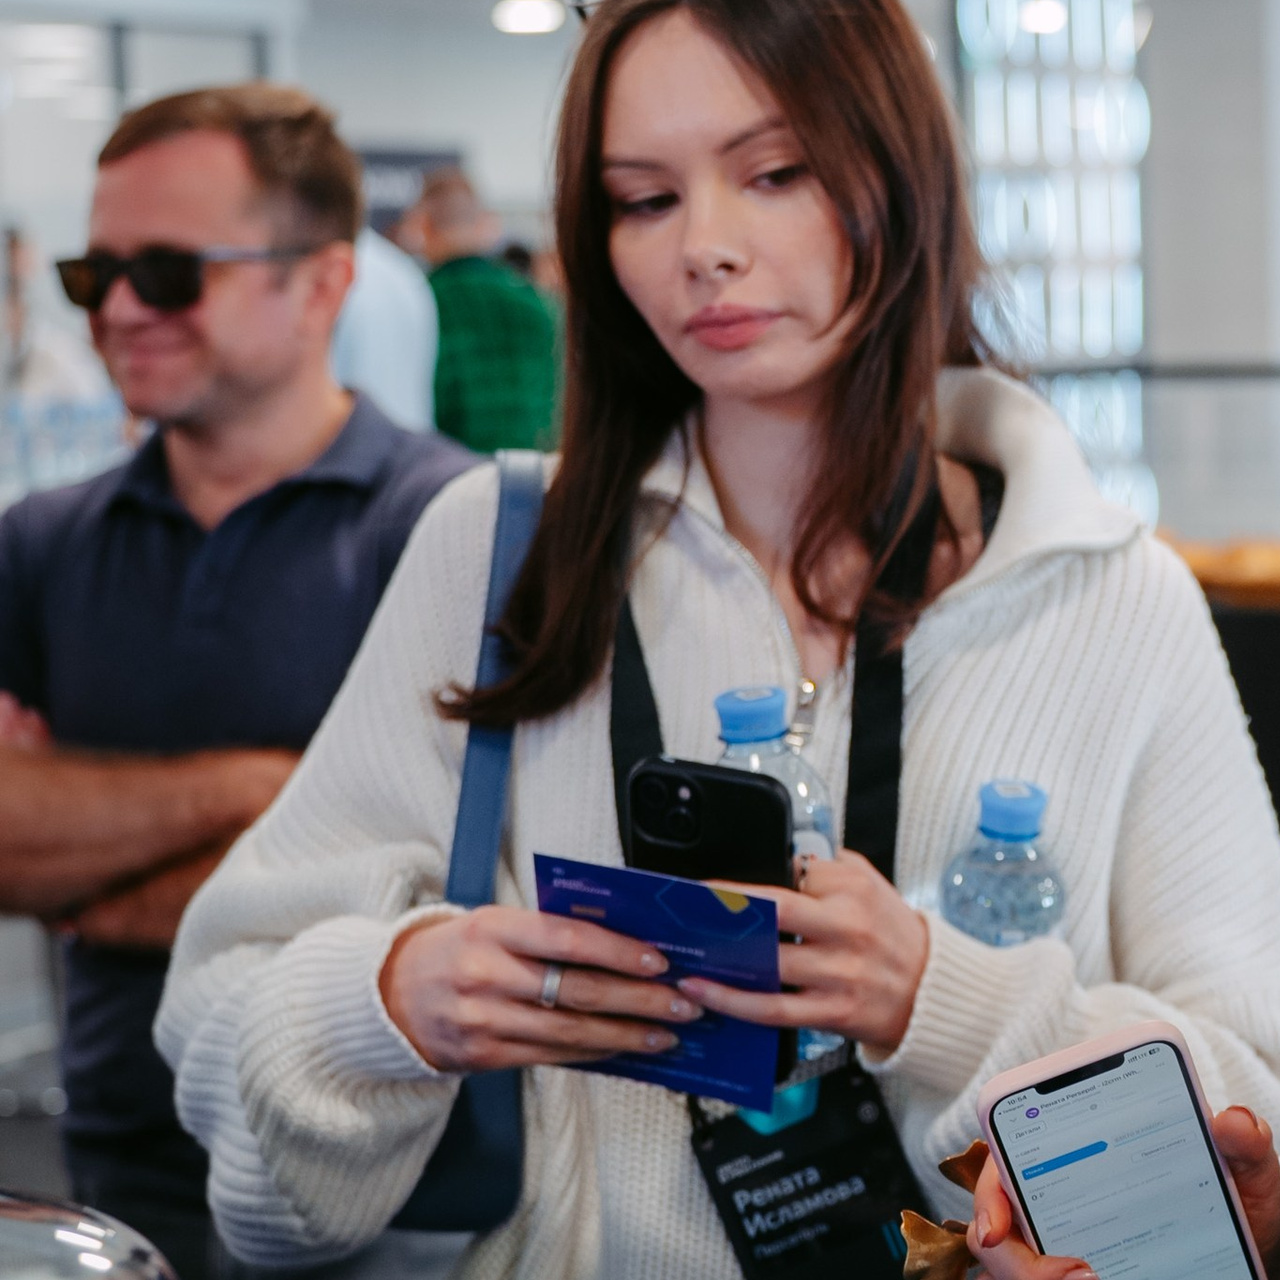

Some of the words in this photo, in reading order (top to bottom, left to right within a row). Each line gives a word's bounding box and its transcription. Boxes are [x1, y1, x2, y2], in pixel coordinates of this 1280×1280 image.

[1007, 1095, 1027, 1105] 10:54
[1040, 1098, 1065, 1109] Рената
[1015, 1126, 1041, 1139] Детали
[733, 1166, 820, 1214] Рената
[742, 1175, 866, 1238] Исламова
